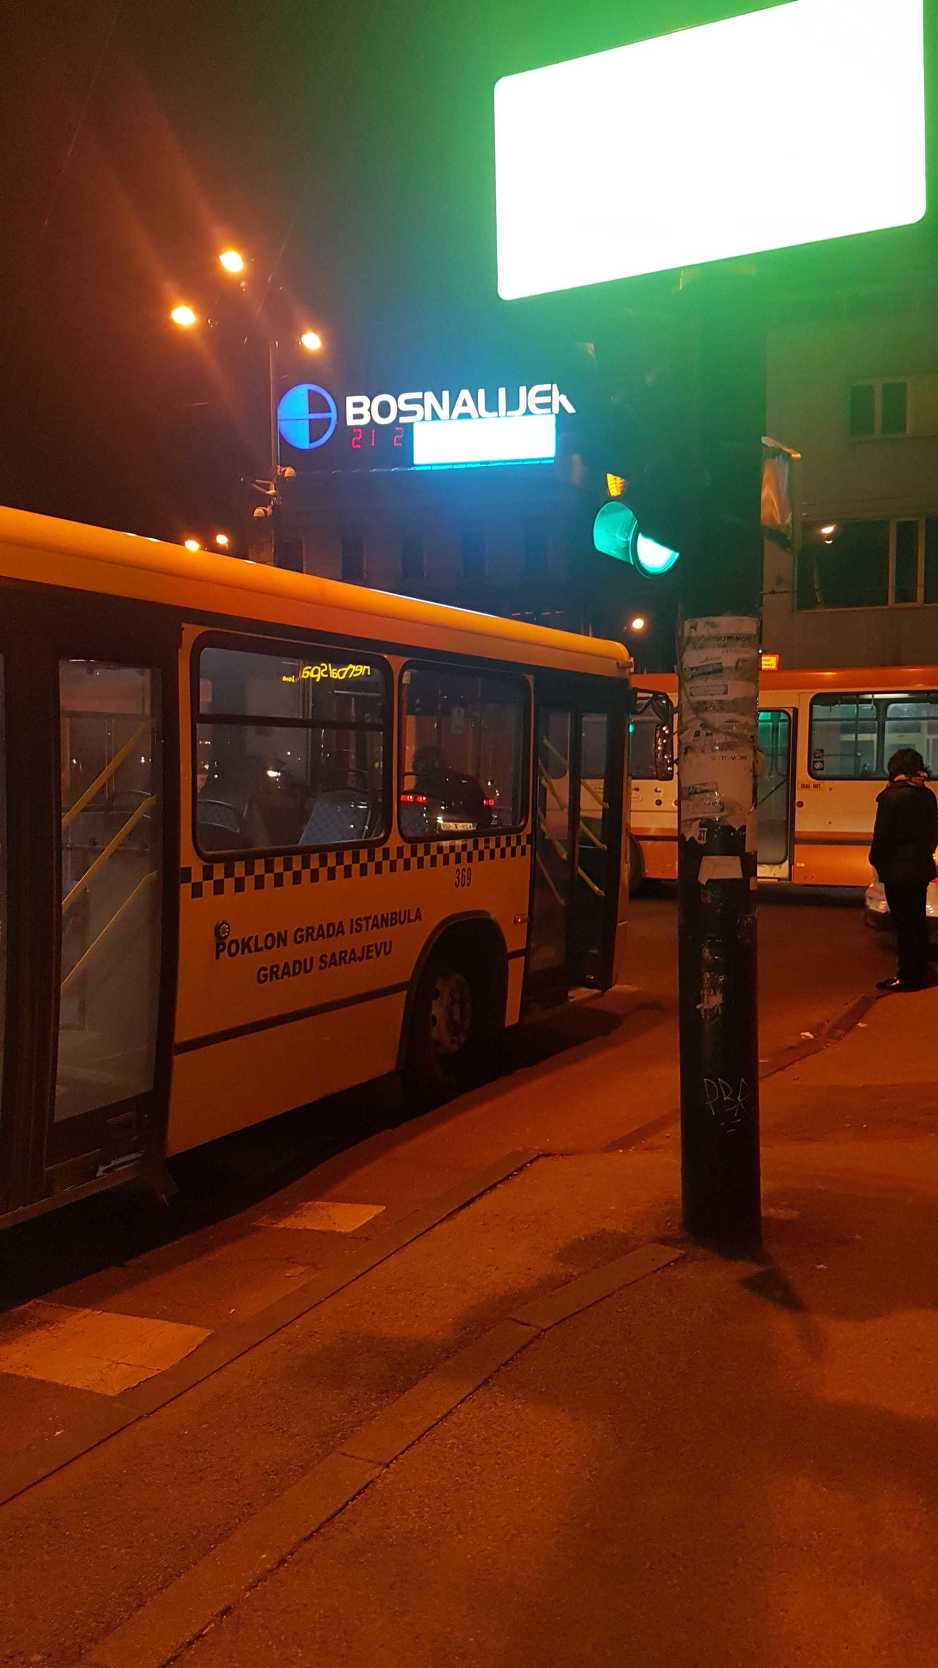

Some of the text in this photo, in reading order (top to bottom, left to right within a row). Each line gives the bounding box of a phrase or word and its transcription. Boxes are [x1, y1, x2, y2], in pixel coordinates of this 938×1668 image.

[345, 383, 576, 426] BOSNALIJEK
[454, 867, 472, 888] 369
[214, 907, 422, 960] POKLON GRADA ISTANBULA
[256, 940, 393, 985] GRADU SARAJEVU
